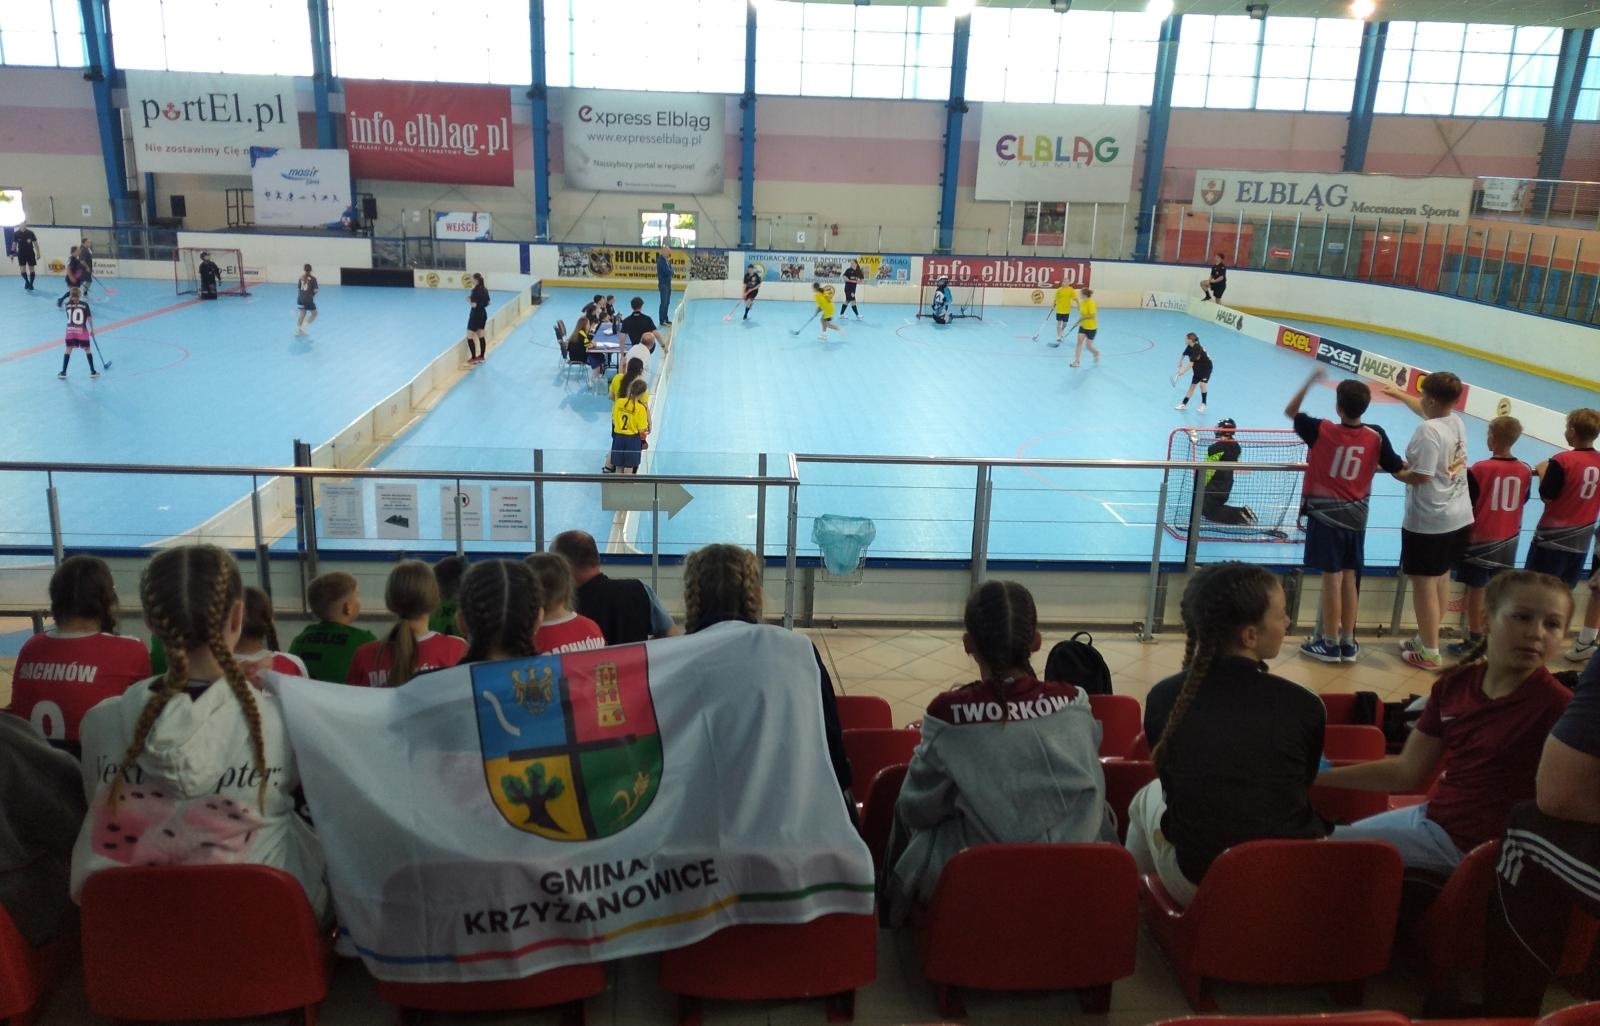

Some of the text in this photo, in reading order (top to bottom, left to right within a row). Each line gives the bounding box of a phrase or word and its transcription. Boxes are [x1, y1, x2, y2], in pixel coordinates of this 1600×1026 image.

[578, 105, 711, 131] express Elbląg
[350, 110, 510, 155] info.elblag.pl
[586, 132, 702, 147] www.expresselblag.pl
[145, 143, 163, 153] Nie
[166, 145, 220, 157] zostawimy
[289, 166, 319, 178] mosir
[1234, 180, 1349, 212] ELBLĄG
[1351, 201, 1461, 218] Mecenasem Sportu
[445, 220, 480, 233] WEJŚCIE
[928, 258, 1085, 288] info.elblag.pl
[67, 308, 84, 325] 10
[1216, 309, 1237, 326] HALEX
[1317, 342, 1360, 367] EXEL
[1361, 357, 1397, 382] HALEX
[621, 414, 629, 431] 2
[1330, 446, 1365, 480] 16
[1491, 476, 1522, 512] 10
[1579, 466, 1600, 500] 8
[540, 859, 649, 896] GMINA
[464, 859, 719, 936] KRZYŻANOWICE
